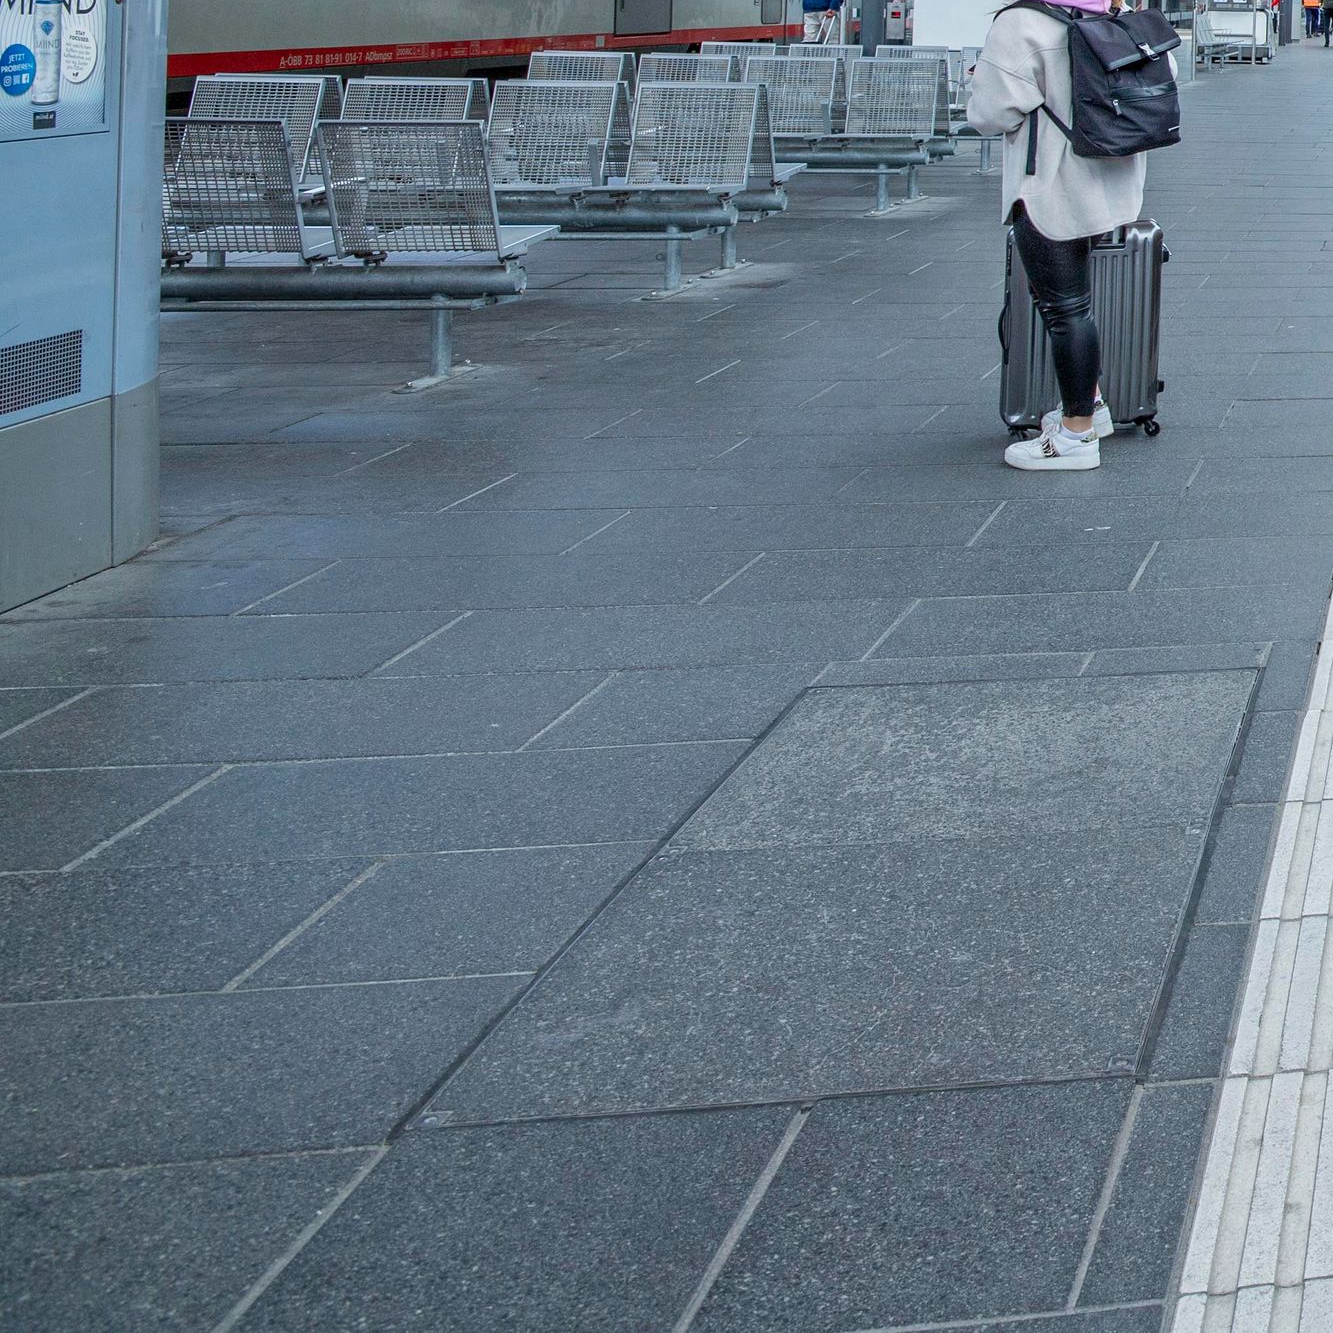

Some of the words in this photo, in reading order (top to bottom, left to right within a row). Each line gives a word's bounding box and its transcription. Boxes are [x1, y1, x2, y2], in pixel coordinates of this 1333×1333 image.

[8, 53, 25, 64] JETZT
[279, 53, 302, 68] A-ÖBB
[304, 55, 313, 65] 73
[315, 54, 324, 65] 81
[0, 63, 33, 73] PROBIEREN
